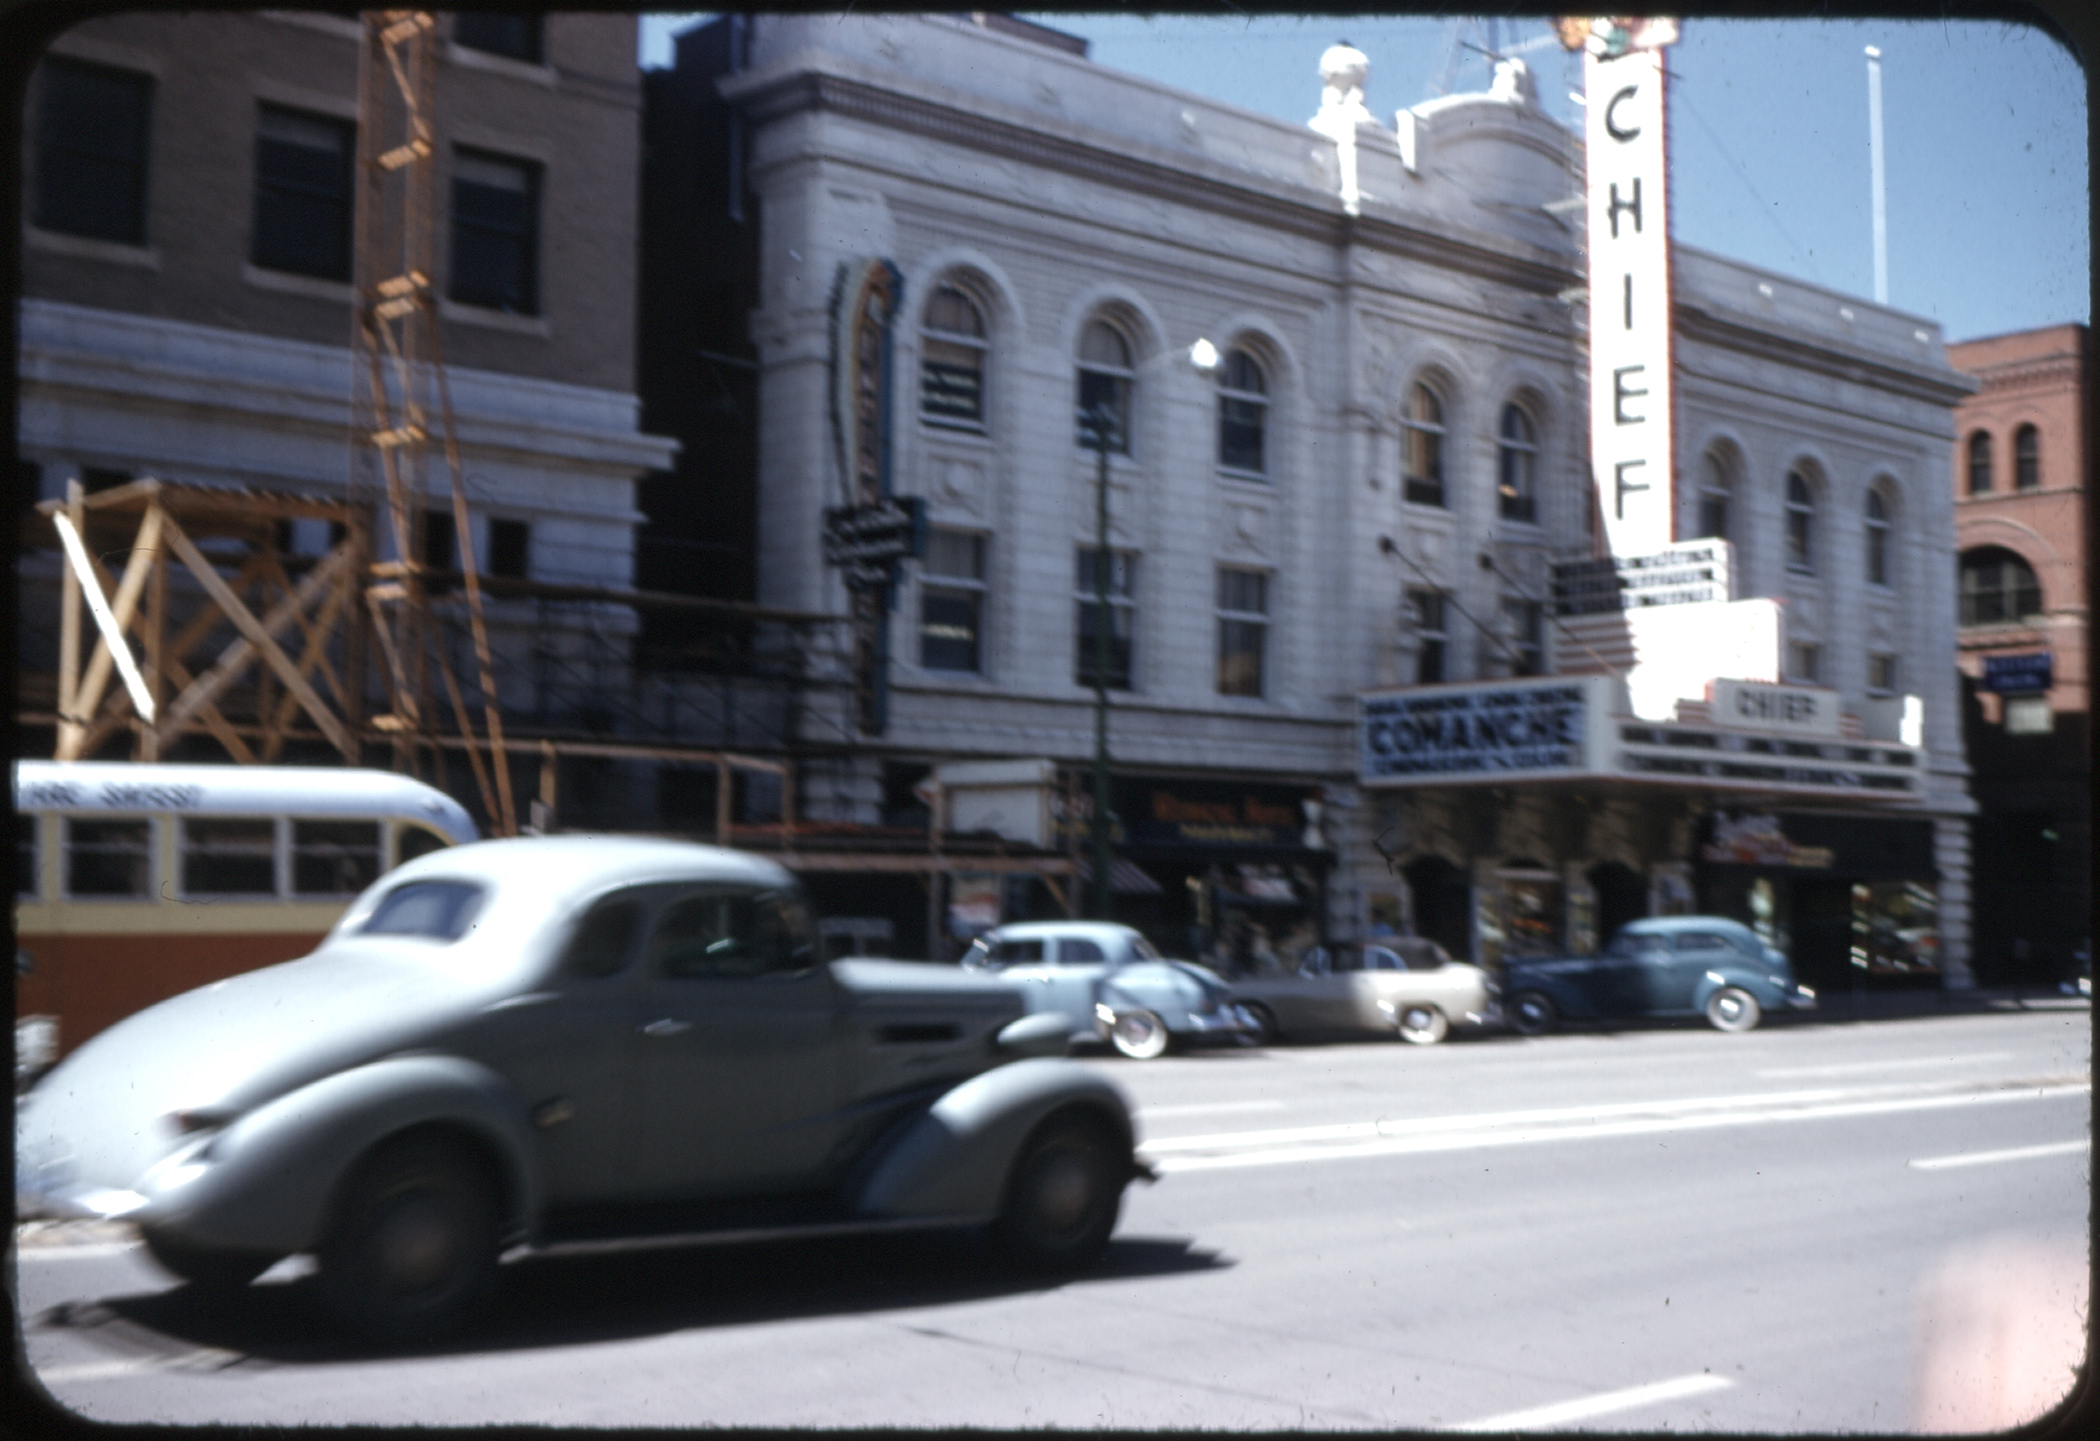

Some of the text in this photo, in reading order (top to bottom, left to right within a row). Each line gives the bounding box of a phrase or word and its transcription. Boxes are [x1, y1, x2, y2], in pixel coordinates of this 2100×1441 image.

[1605, 85, 1649, 520] CHIEF
[1735, 688, 1818, 722] CHIEF
[1367, 707, 1583, 754] COMANCHE
